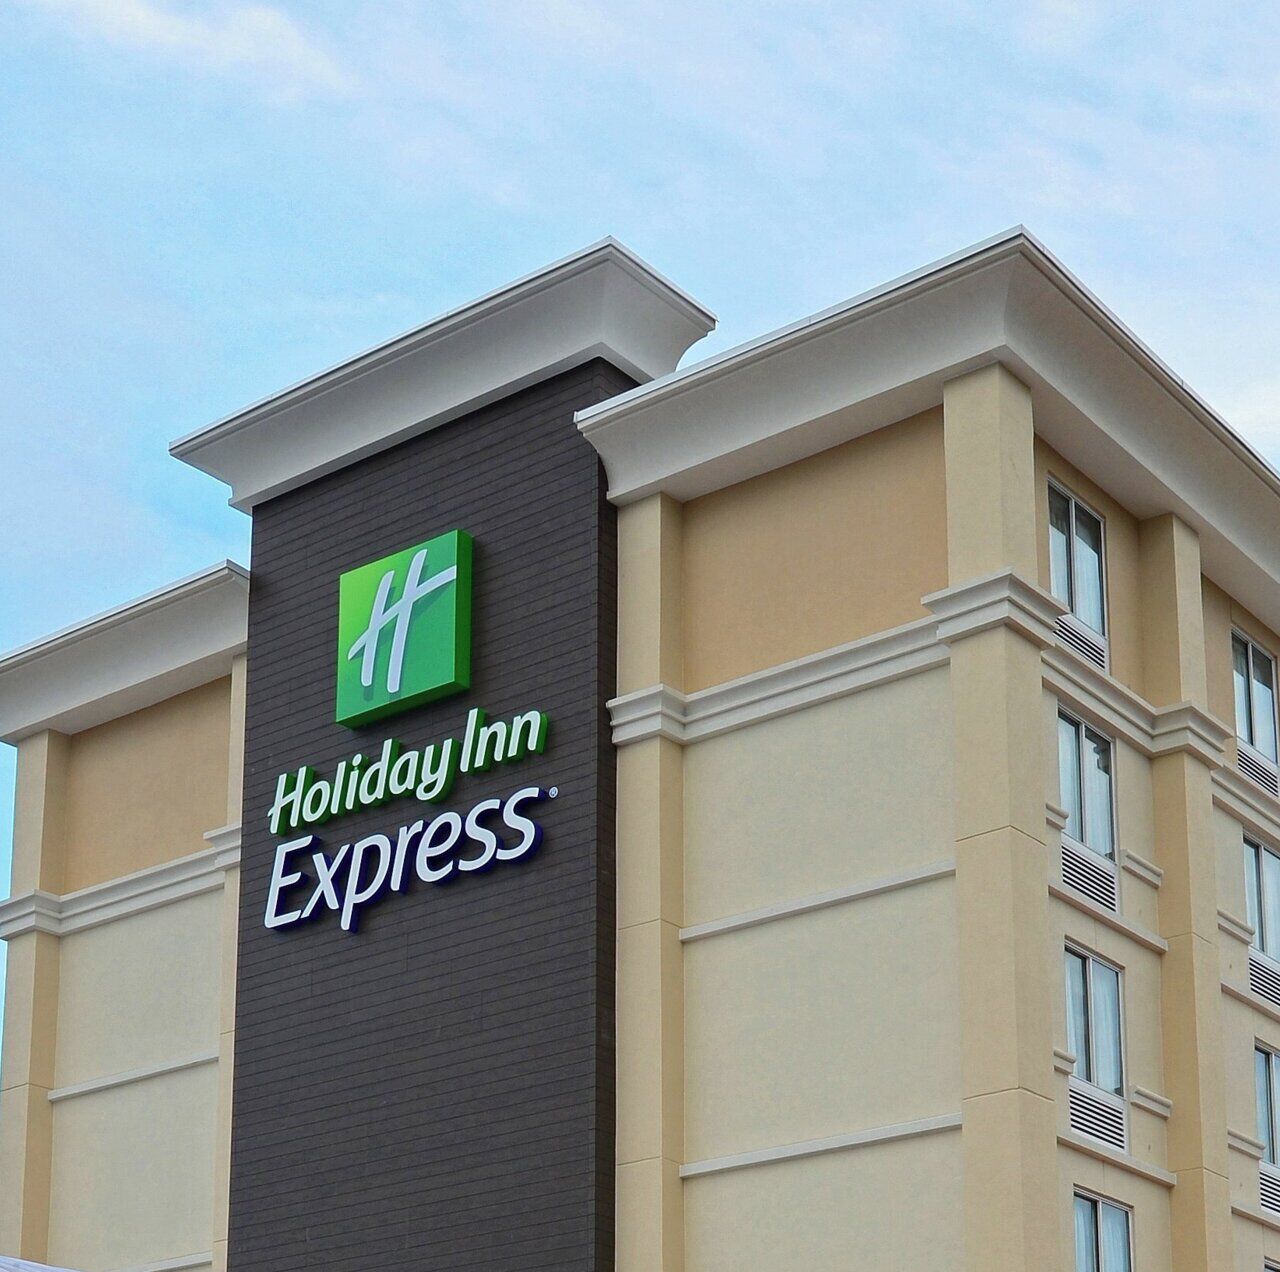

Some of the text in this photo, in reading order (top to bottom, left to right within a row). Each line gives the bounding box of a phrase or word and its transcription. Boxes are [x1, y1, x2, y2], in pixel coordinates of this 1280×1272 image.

[348, 549, 457, 694] H
[267, 707, 542, 834] Holiday Inn
[264, 787, 541, 931] Express
